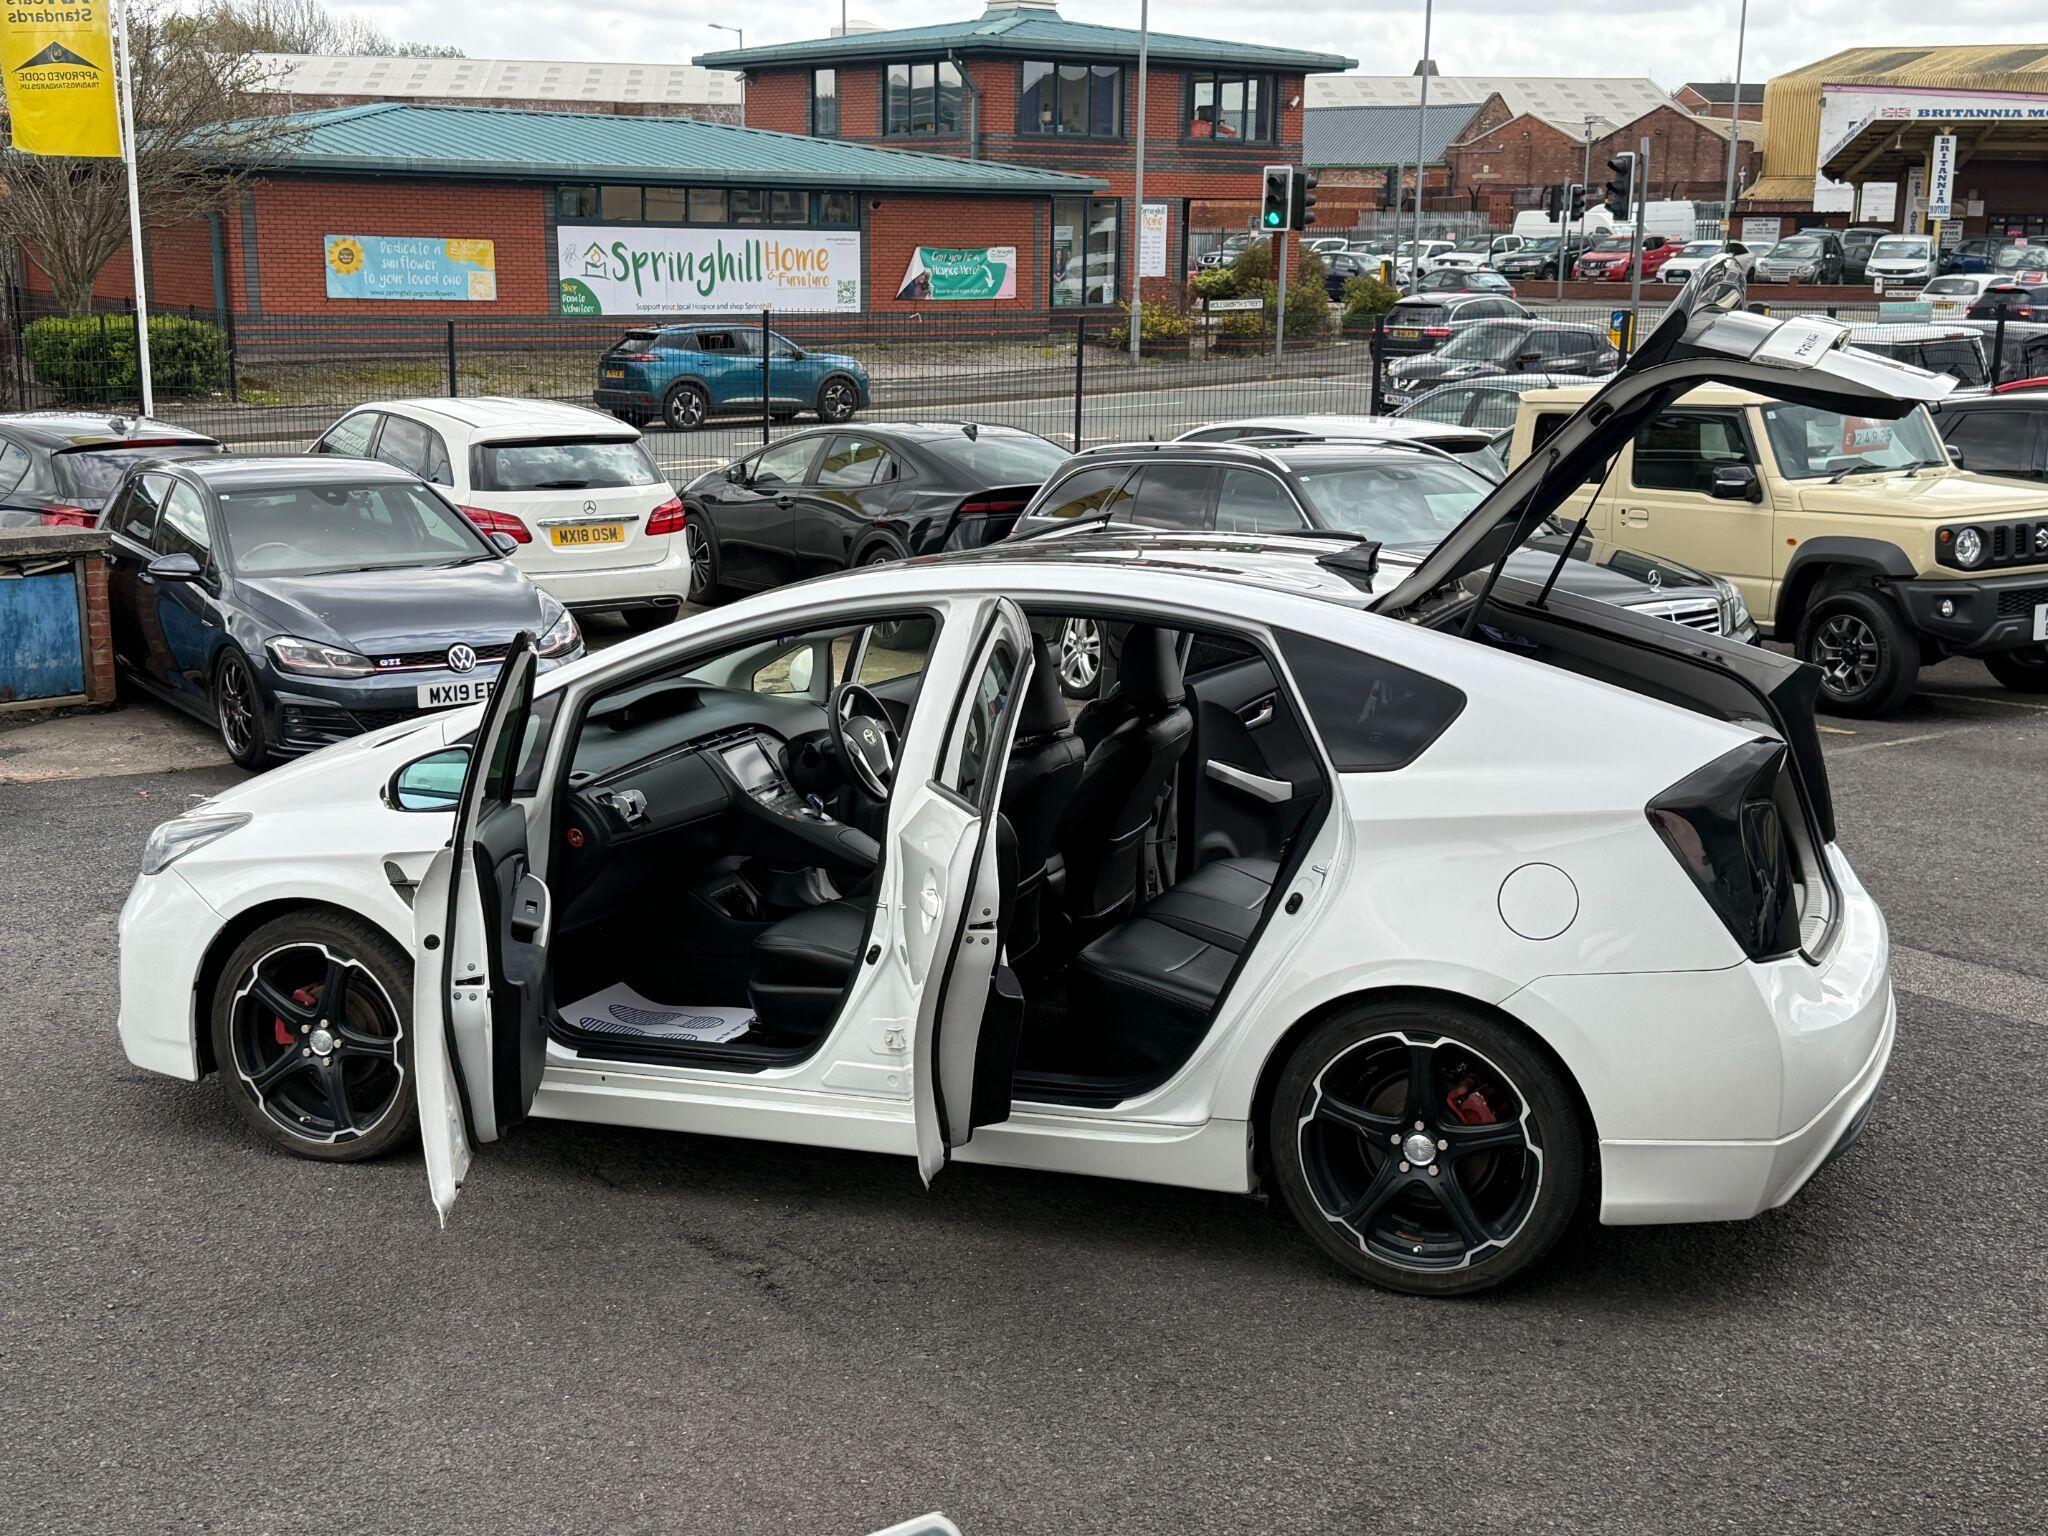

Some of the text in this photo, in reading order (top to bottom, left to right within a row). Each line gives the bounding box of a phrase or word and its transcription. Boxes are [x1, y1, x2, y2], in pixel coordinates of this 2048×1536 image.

[1917, 108, 2048, 118] BRITANNIA M
[1936, 137, 1950, 204] BRITANNIA
[1929, 205, 1950, 215] MOTORS
[380, 241, 430, 255] Dedicate
[381, 257, 438, 271] sunflower
[931, 251, 946, 262] Can
[949, 254, 962, 265] you
[611, 238, 830, 297] Springhill Home
[932, 264, 959, 278] Hospice
[363, 271, 462, 288] to your loved one
[778, 272, 830, 288] Furniture
[562, 303, 595, 313] Volunteer
[636, 303, 660, 311] Support
[692, 303, 715, 311] Hospice
[729, 303, 744, 311] shop
[745, 303, 772, 311] Springhill
[559, 527, 618, 544] MX18 OSM
[379, 658, 402, 666] GTI
[429, 684, 469, 704] MX19
